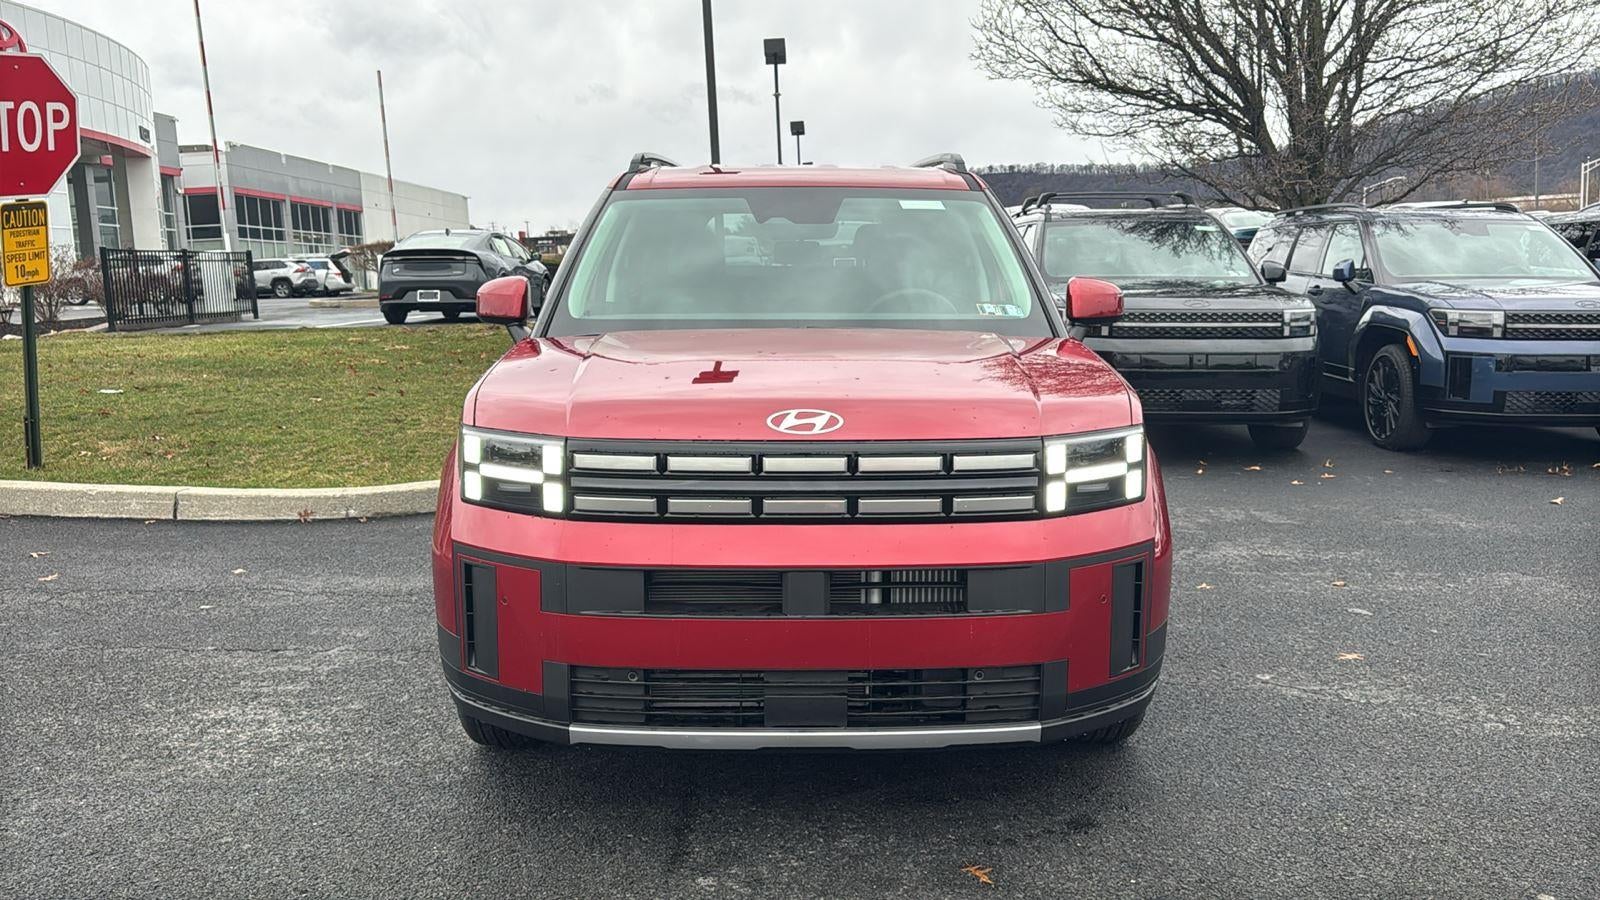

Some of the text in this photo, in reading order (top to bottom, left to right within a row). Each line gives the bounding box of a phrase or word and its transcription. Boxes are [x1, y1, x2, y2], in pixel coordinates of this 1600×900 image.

[0, 101, 70, 152] TOP
[3, 208, 45, 229] CAUTION
[9, 229, 40, 238] PEDESTRIAN
[15, 239, 36, 248] TRAFFIC
[6, 251, 45, 263] SPEED LIMIT
